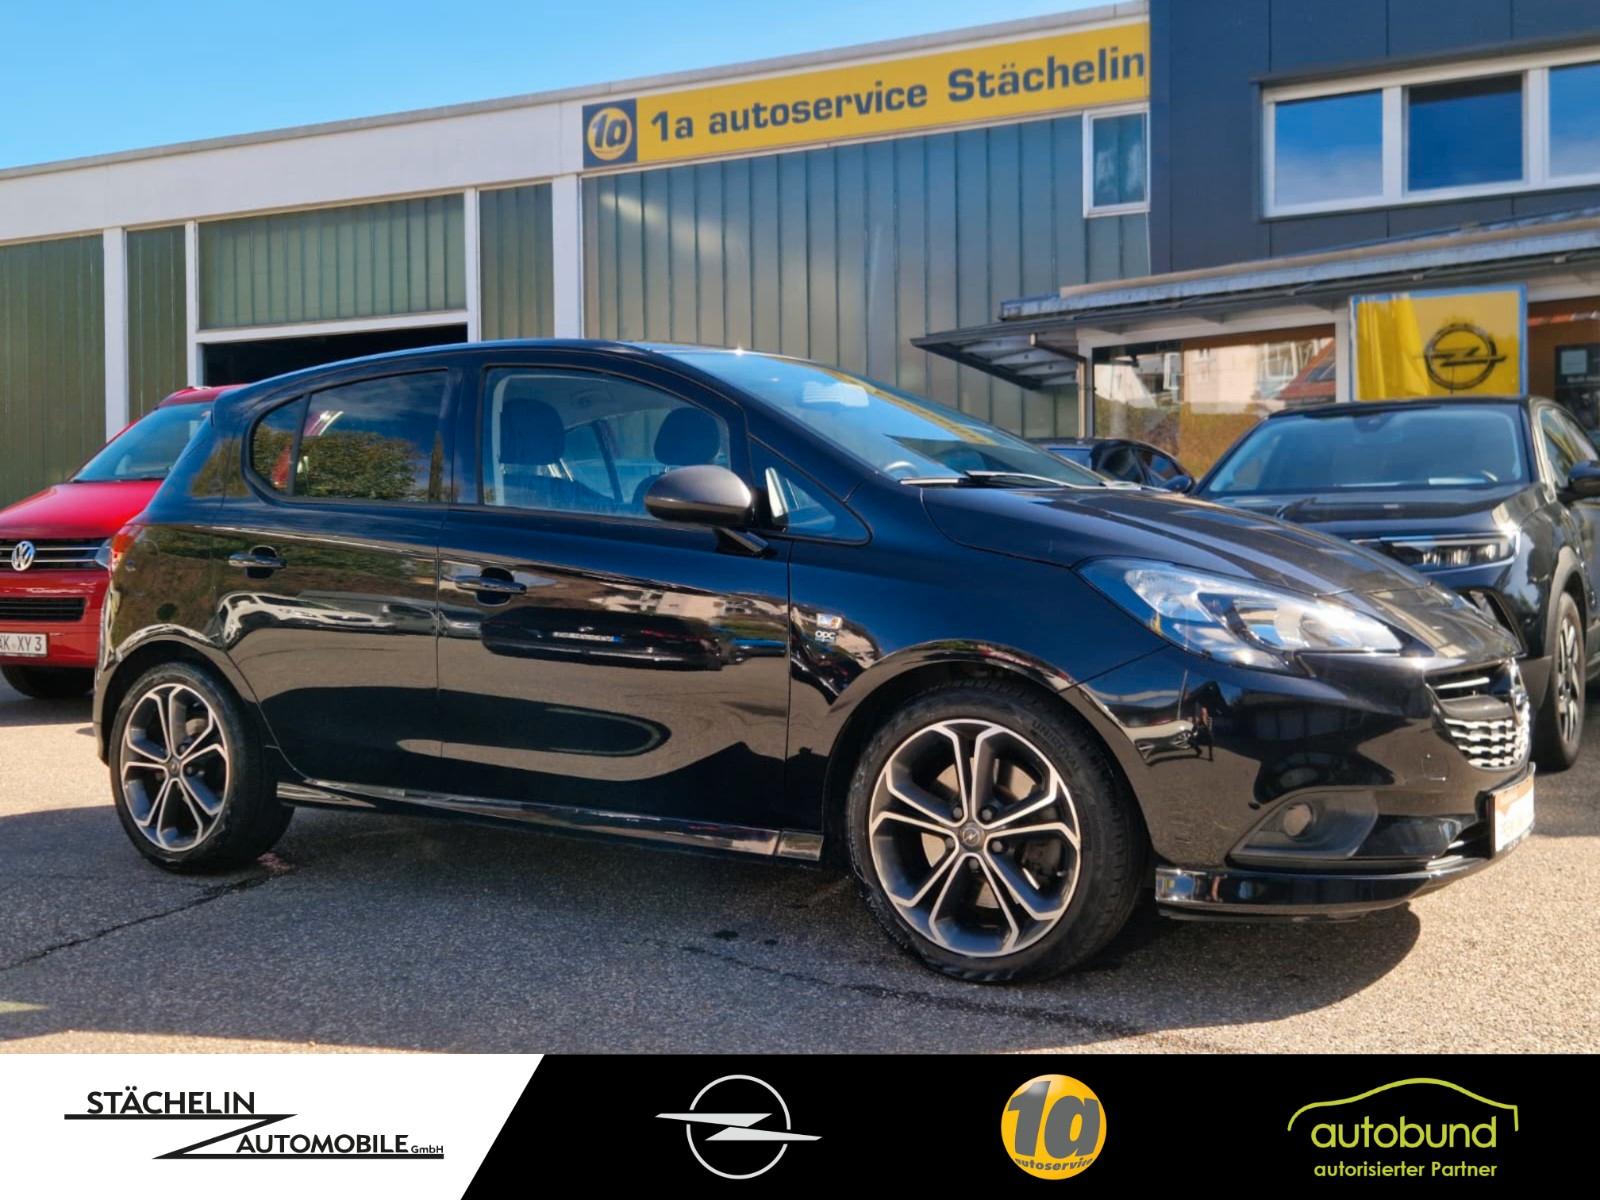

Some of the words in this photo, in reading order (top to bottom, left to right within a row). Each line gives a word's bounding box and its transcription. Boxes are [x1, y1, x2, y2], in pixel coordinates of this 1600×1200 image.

[651, 110, 694, 142] 1a
[708, 80, 928, 135] autoservice
[947, 46, 1146, 103] Stächelin
[34, 636, 42, 652] 3
